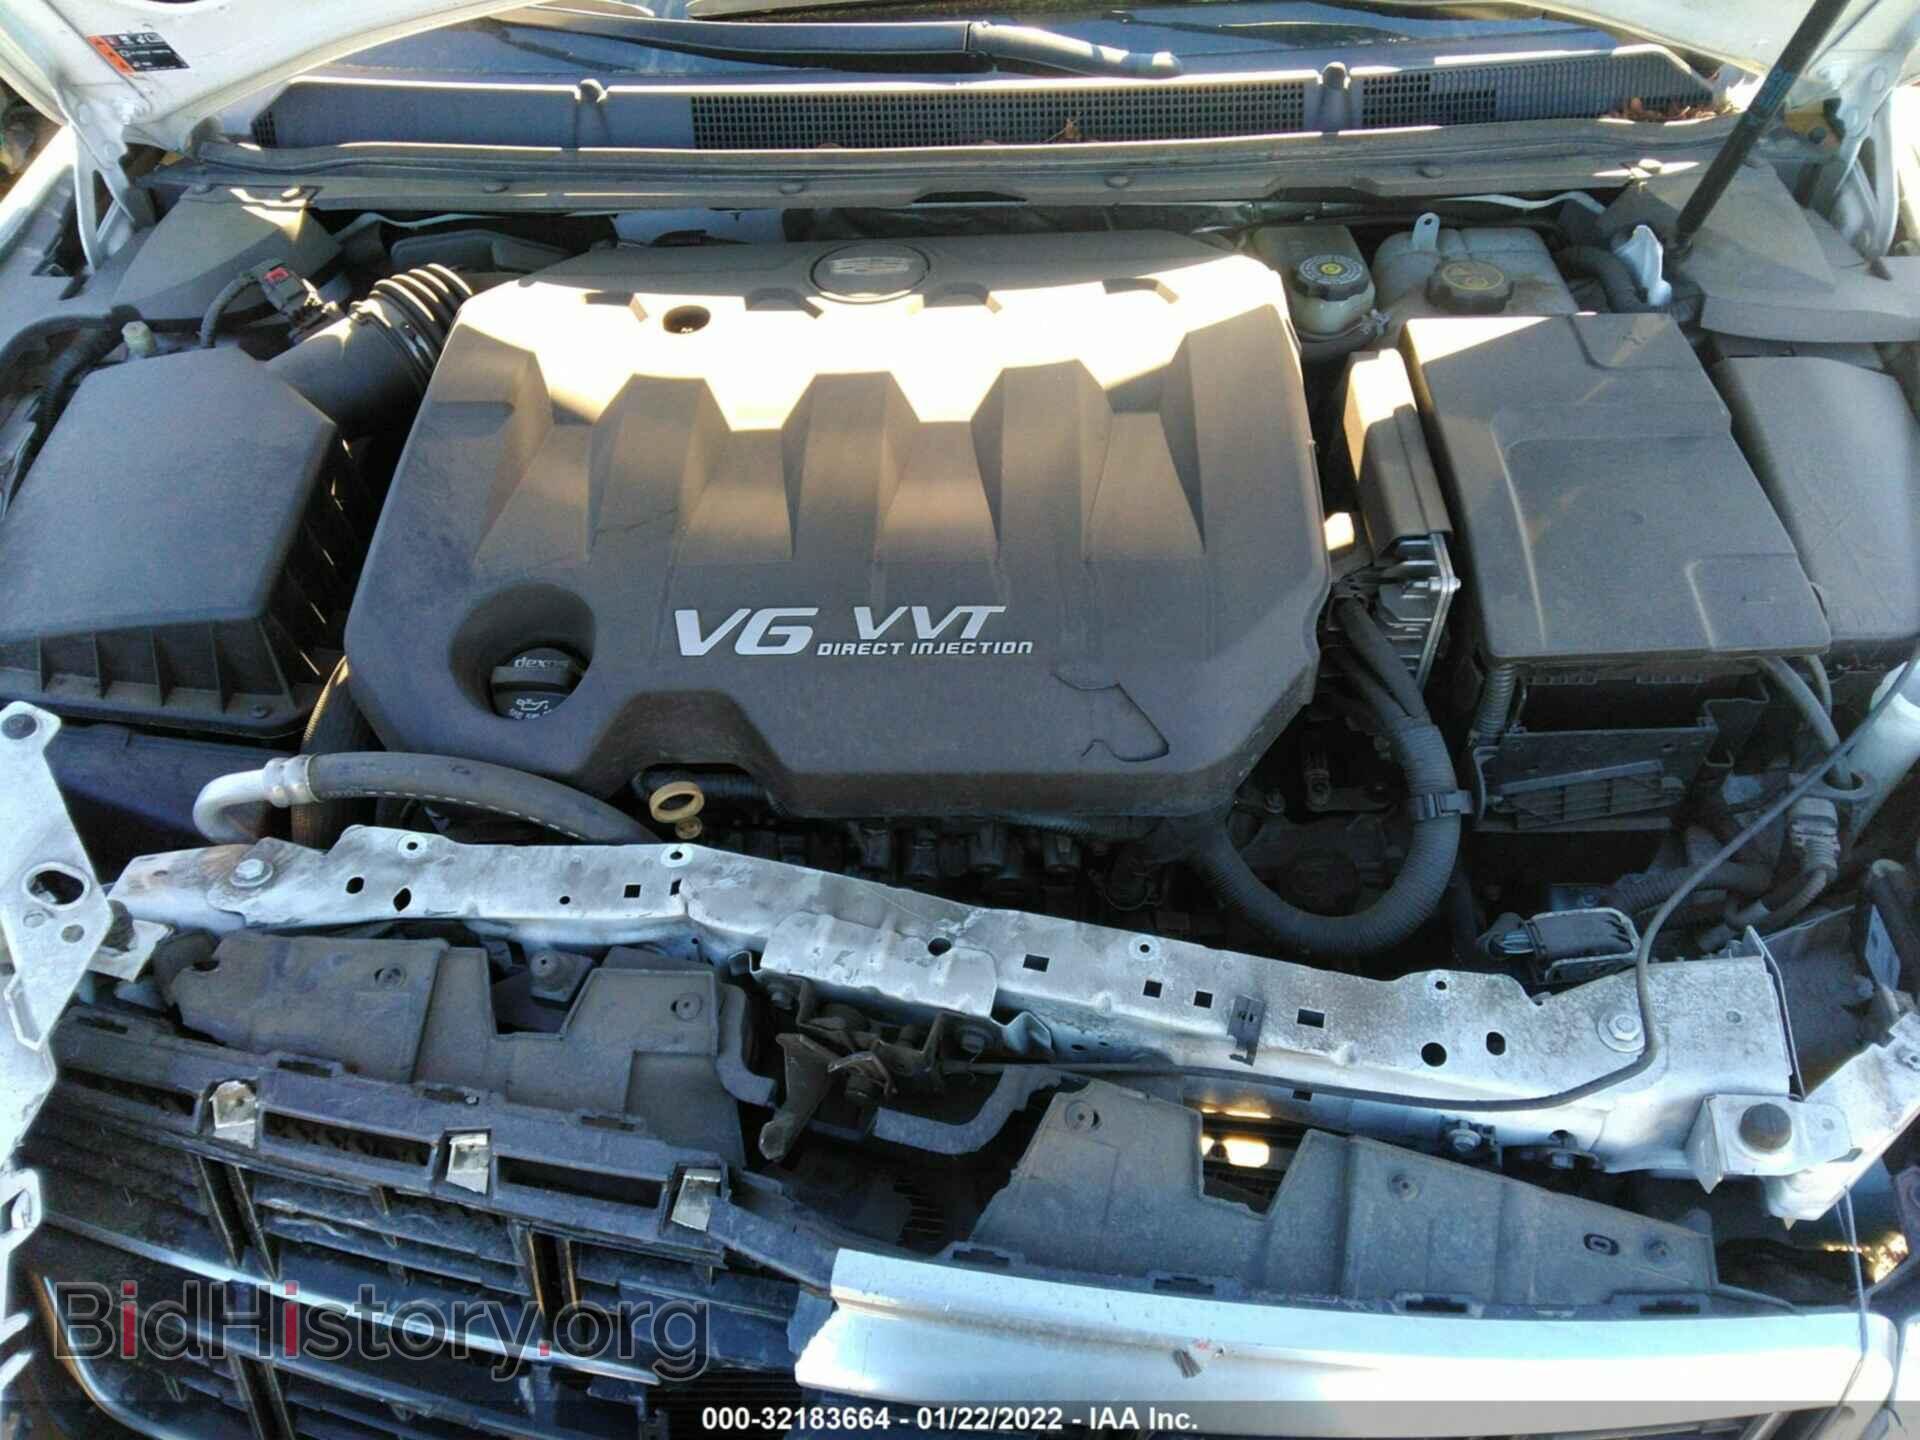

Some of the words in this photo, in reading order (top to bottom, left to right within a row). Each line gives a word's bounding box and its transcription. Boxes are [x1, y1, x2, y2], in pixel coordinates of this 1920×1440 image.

[675, 608, 819, 656] V6
[854, 606, 1006, 640] VVT
[817, 642, 904, 656] DIRECT
[910, 641, 1033, 655] INJECTION
[514, 657, 569, 669] dex
